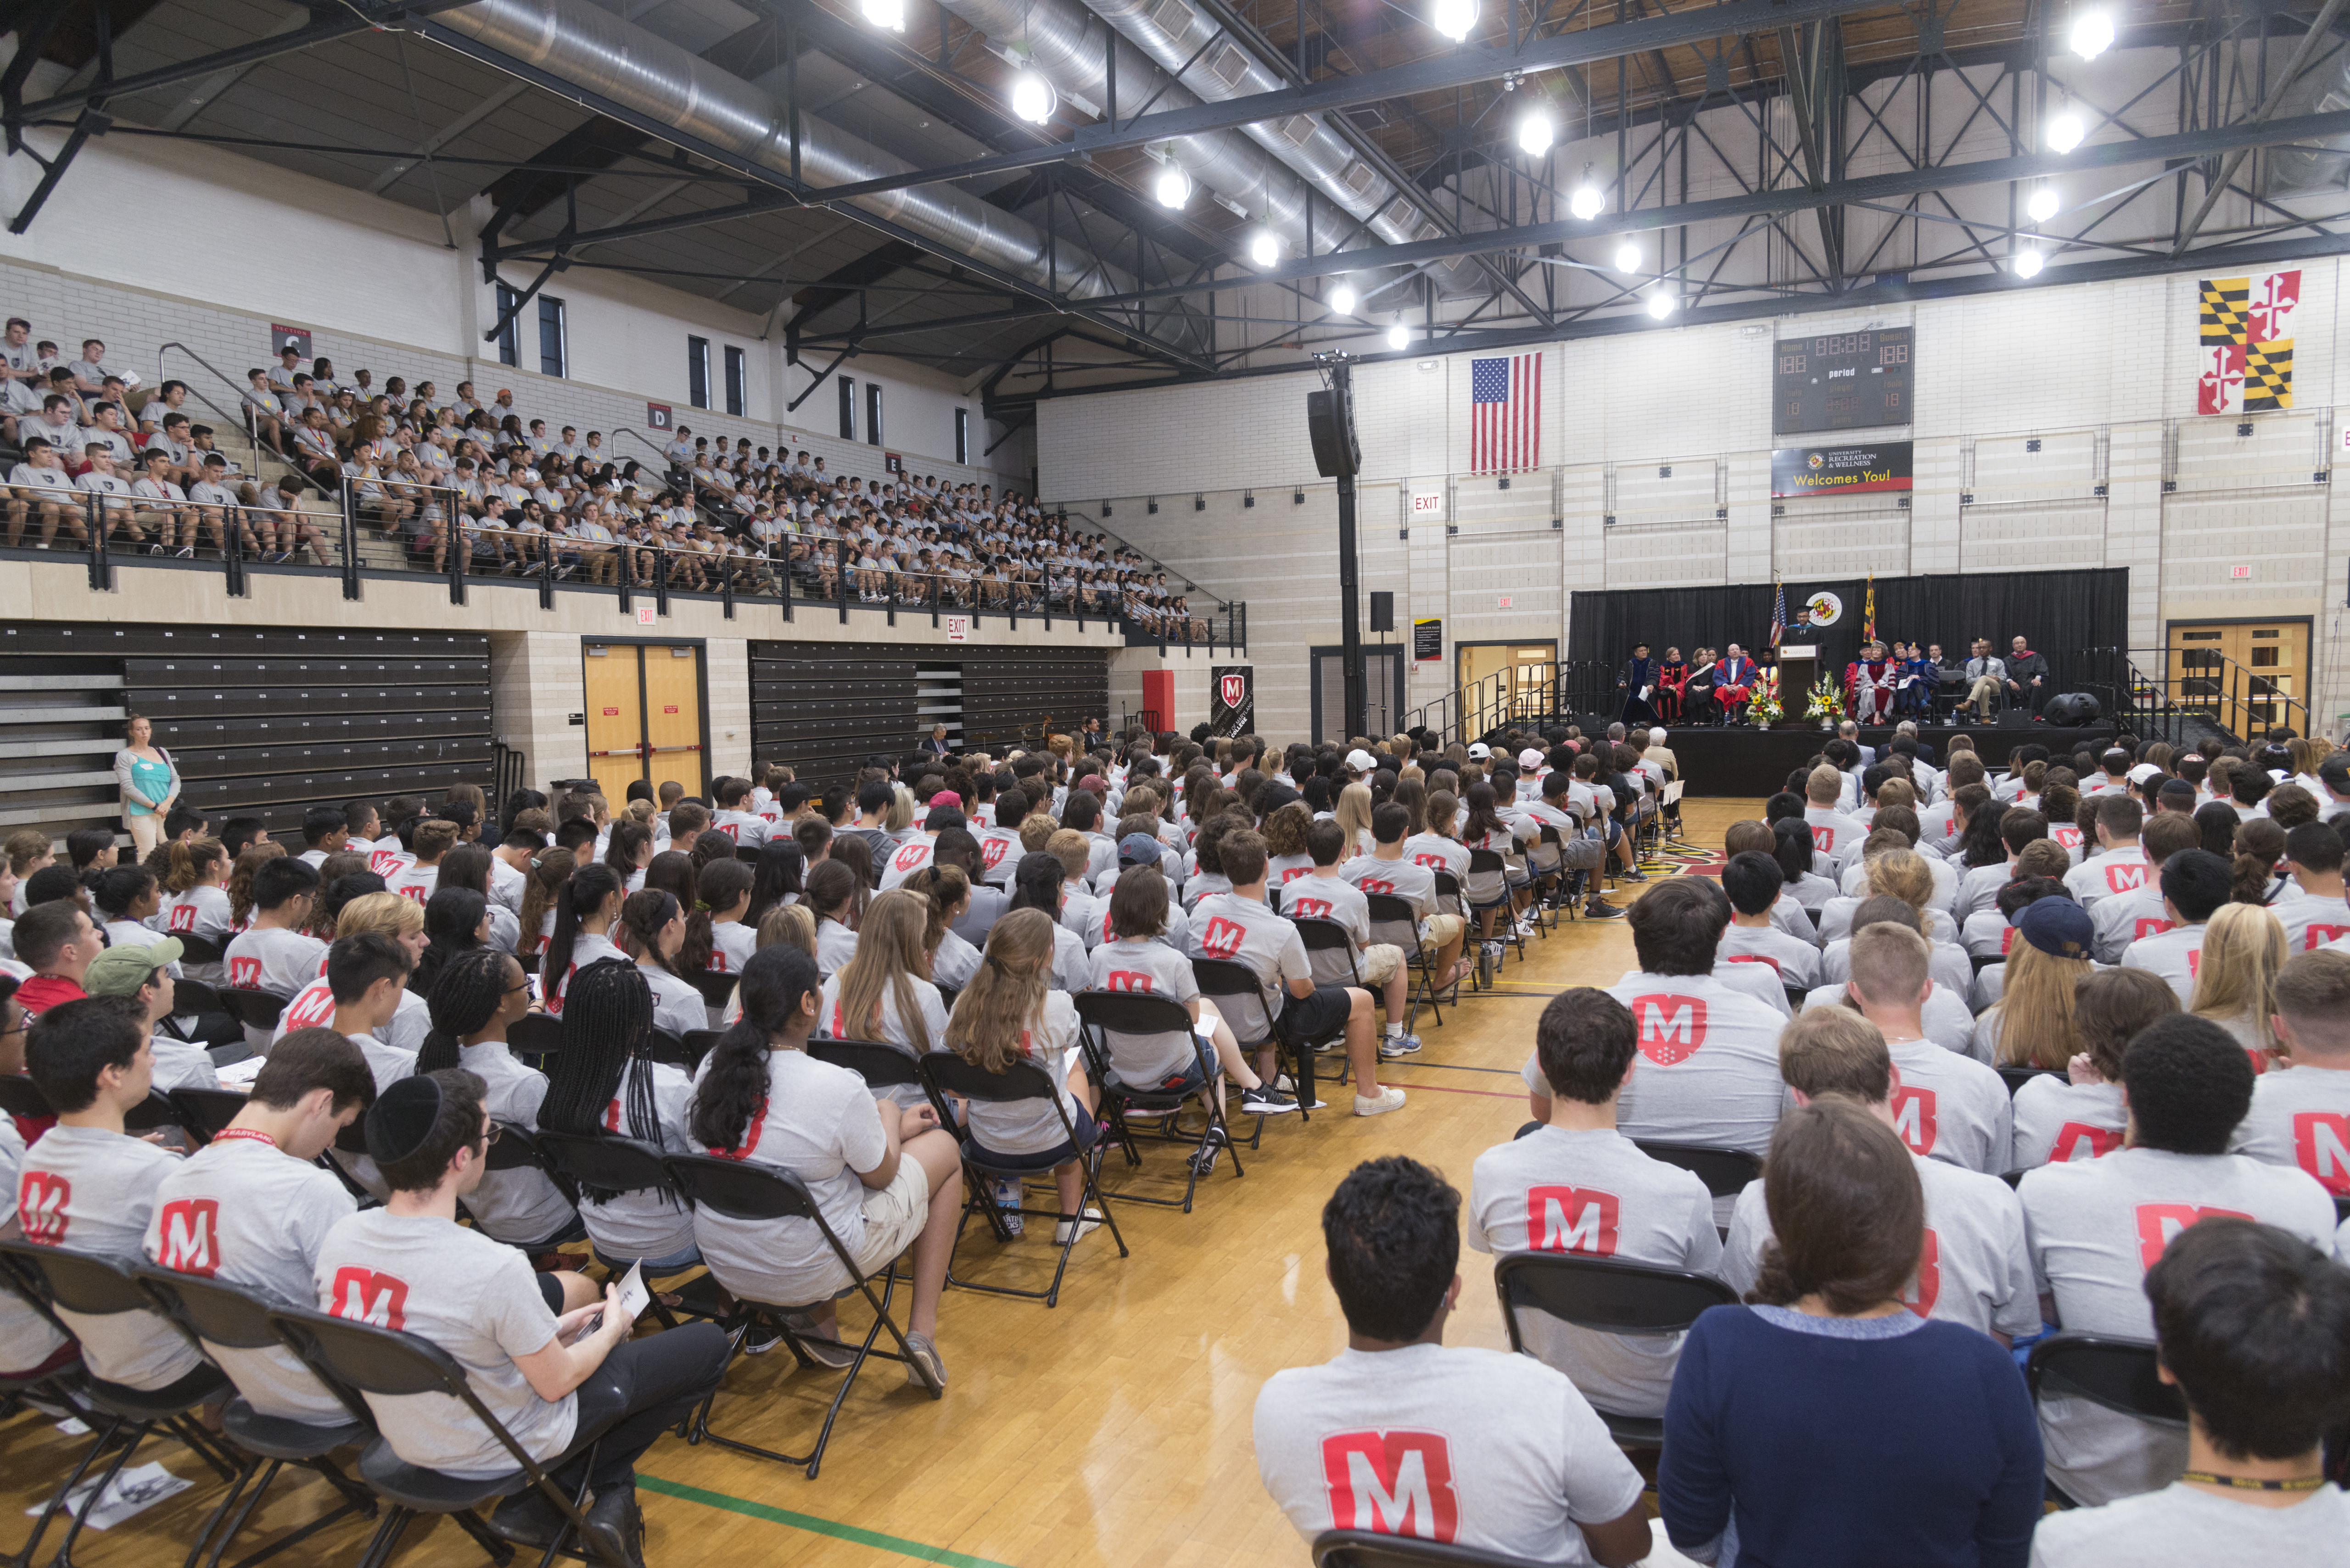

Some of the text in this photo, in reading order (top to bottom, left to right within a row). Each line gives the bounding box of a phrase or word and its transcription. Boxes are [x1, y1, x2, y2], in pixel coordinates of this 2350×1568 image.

[276, 326, 307, 335] SECTION
[1880, 332, 1908, 342] Guests
[286, 336, 300, 353] C
[1781, 344, 1802, 352] Home
[1829, 368, 1855, 379] period
[655, 411, 665, 425] D
[891, 459, 896, 471] E
[1829, 454, 1876, 462] RECREATION
[1793, 469, 1890, 486] Welcomes You!
[1416, 497, 1438, 509] EXIT
[2234, 567, 2249, 576] EXIT
[1808, 593, 1834, 604] UNIVERSITY
[641, 609, 652, 622] EXIT
[949, 619, 965, 632] EXIT
[1226, 680, 1239, 697] M
[1236, 695, 1251, 714] HONORS
[1236, 702, 1253, 724] MARYLAND
[1212, 705, 1228, 725] HONORS
[1231, 717, 1248, 738] COLLEGE
[900, 847, 922, 863] M
[986, 842, 1004, 860] M
[377, 861, 398, 876] M
[2114, 867, 2147, 889] M
[176, 909, 191, 929] M
[1206, 922, 1241, 951] M
[235, 963, 255, 983] M
[292, 992, 334, 1021] M
[1643, 1003, 1692, 1043] M
[26, 1182, 62, 1233] M
[1539, 1198, 1600, 1250] M
[166, 1210, 209, 1267] M
[1347, 1450, 1435, 1540] M
